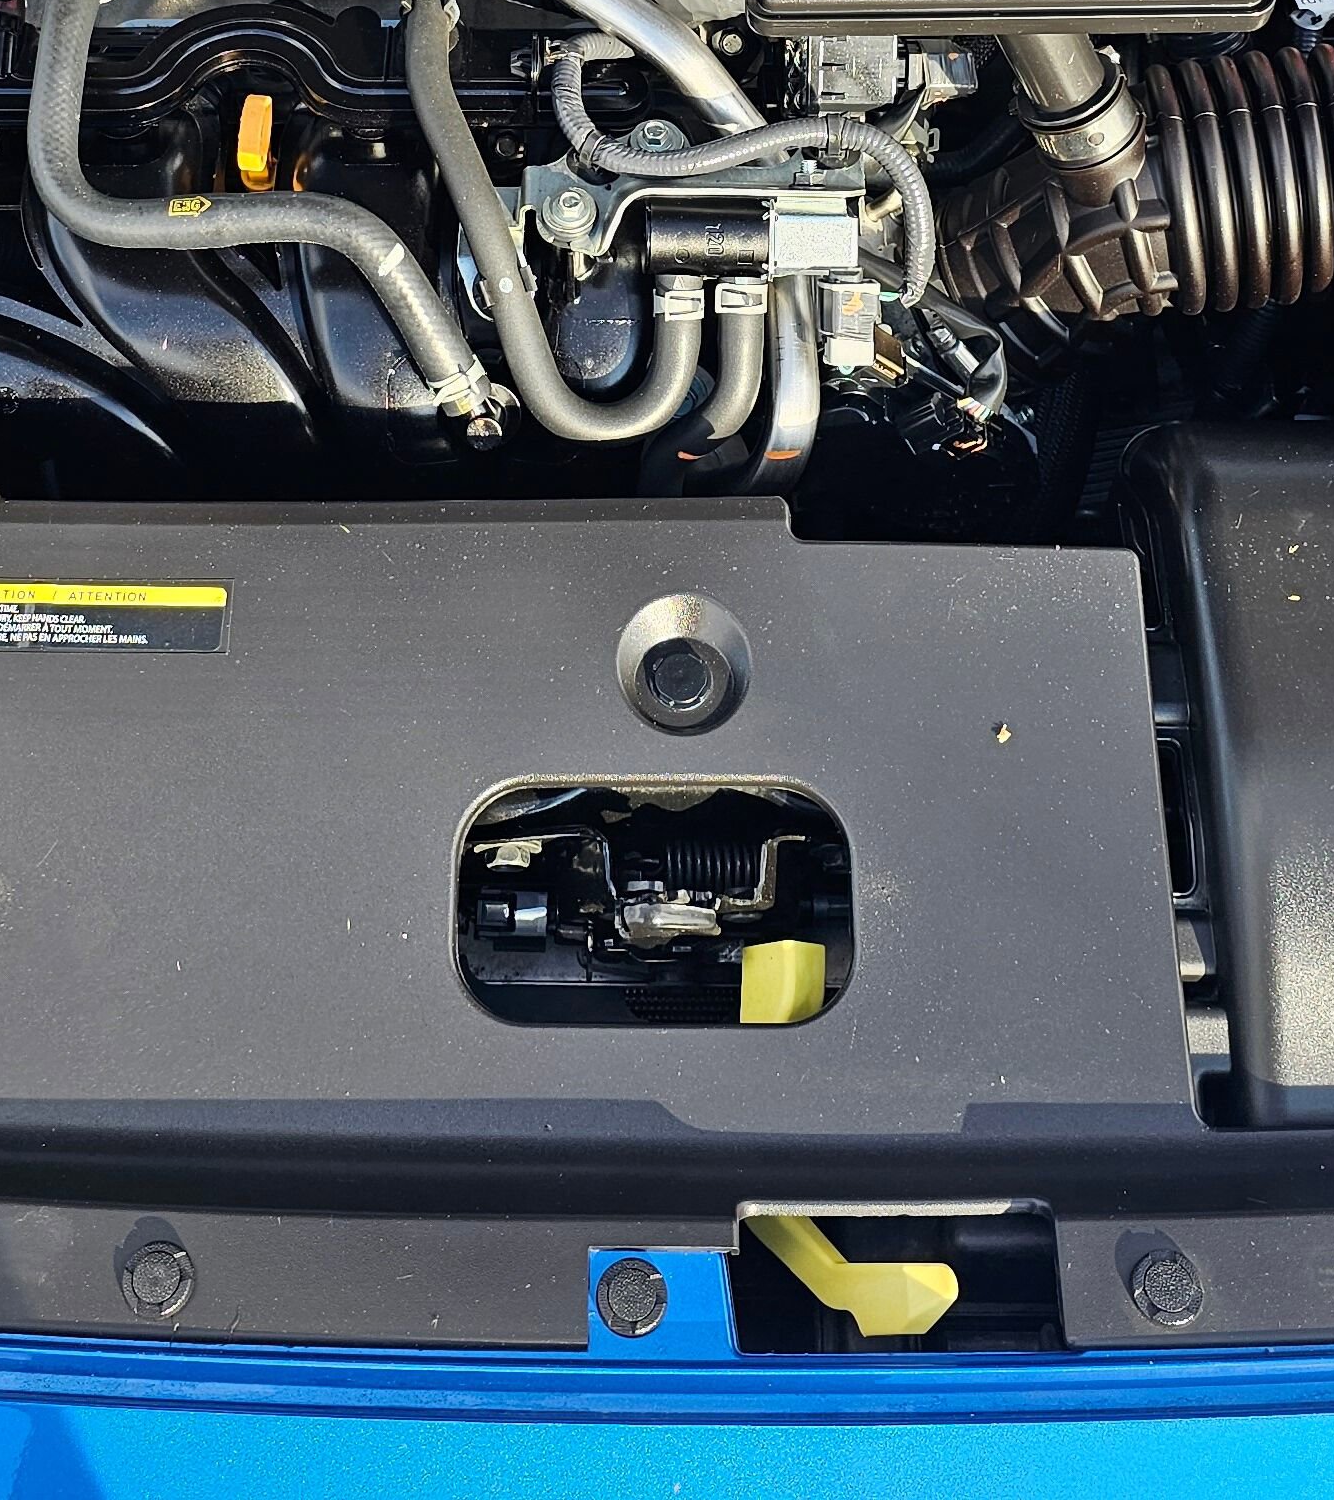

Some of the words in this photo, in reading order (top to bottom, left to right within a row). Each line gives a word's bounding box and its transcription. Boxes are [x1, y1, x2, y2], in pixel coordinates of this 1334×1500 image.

[68, 591, 147, 602] ATTENTION
[13, 614, 31, 623] KEEP
[31, 614, 59, 623] HANDS
[49, 623, 73, 633] TOUT
[23, 632, 39, 642] PAS
[51, 633, 103, 643] APPROCHER
[103, 634, 117, 643] LES
